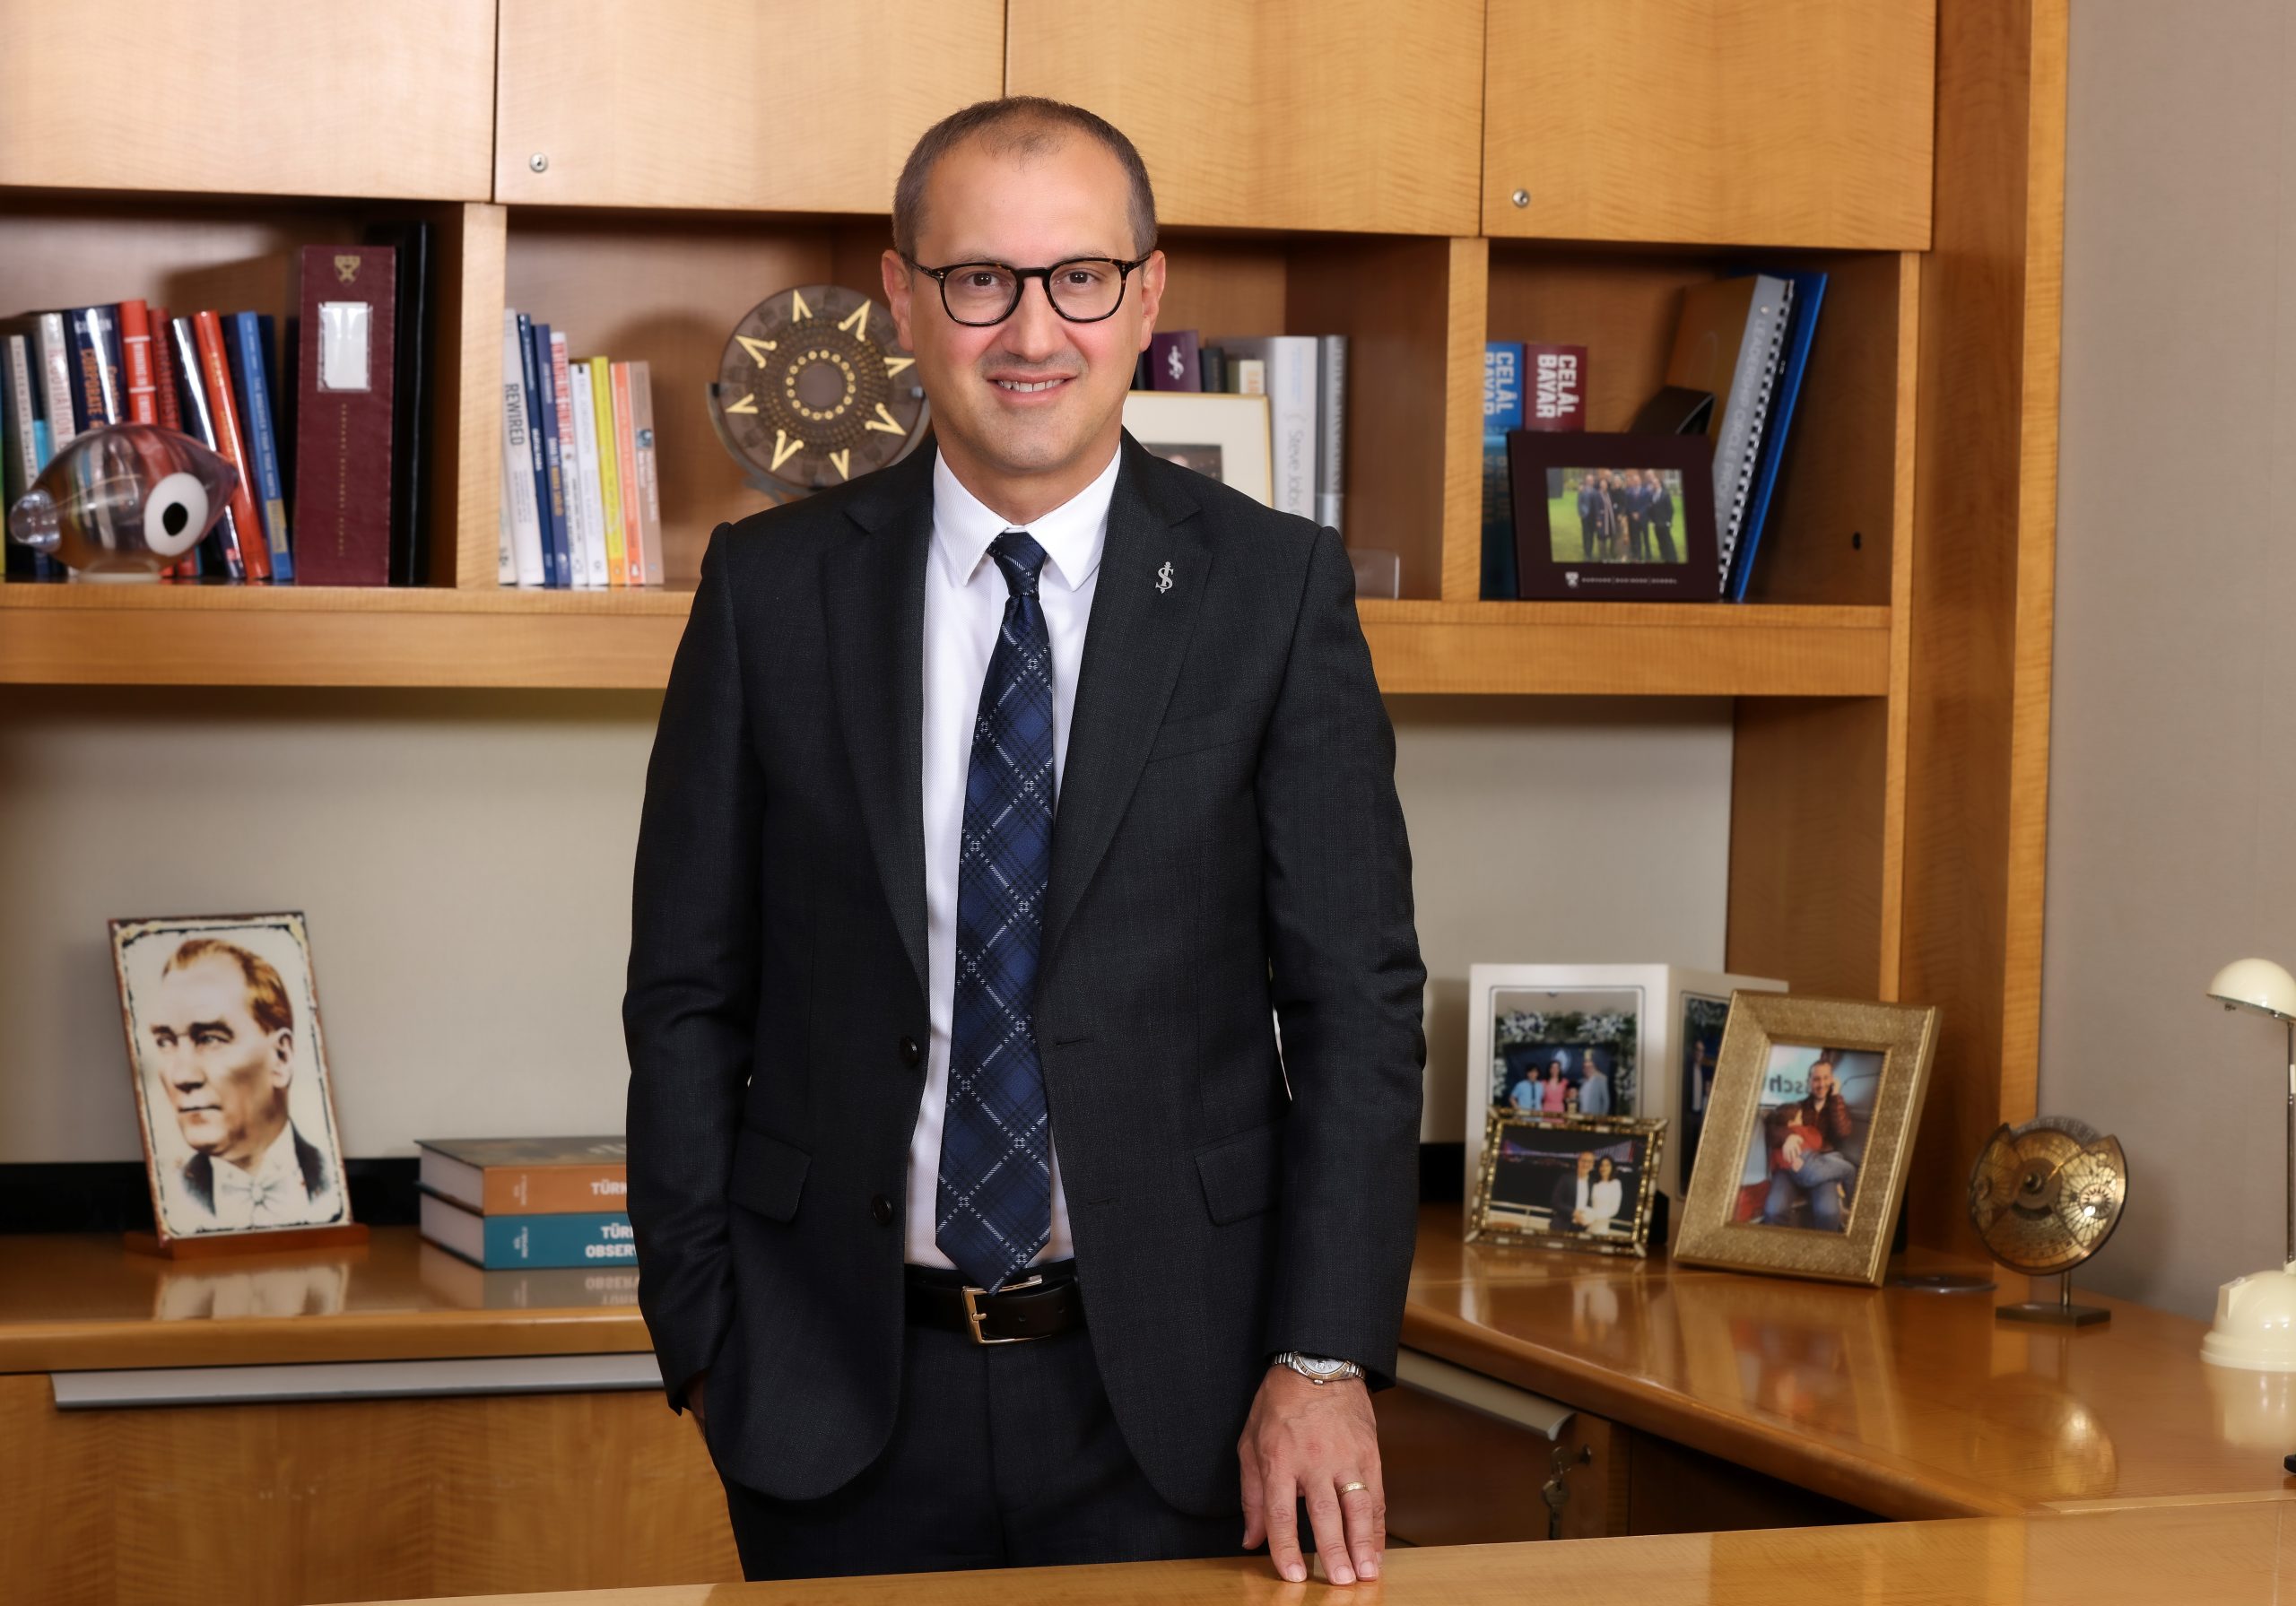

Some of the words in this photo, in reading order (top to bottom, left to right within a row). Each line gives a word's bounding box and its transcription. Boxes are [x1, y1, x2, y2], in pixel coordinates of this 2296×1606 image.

[1536, 354, 1557, 418] BAYAR
[1740, 319, 1766, 406] LEADERSHIP
[504, 383, 526, 447] REWIRED
[1726, 408, 1746, 460] CIRCLE
[1288, 429, 1304, 470] Steve
[1287, 473, 1303, 507] Jobs
